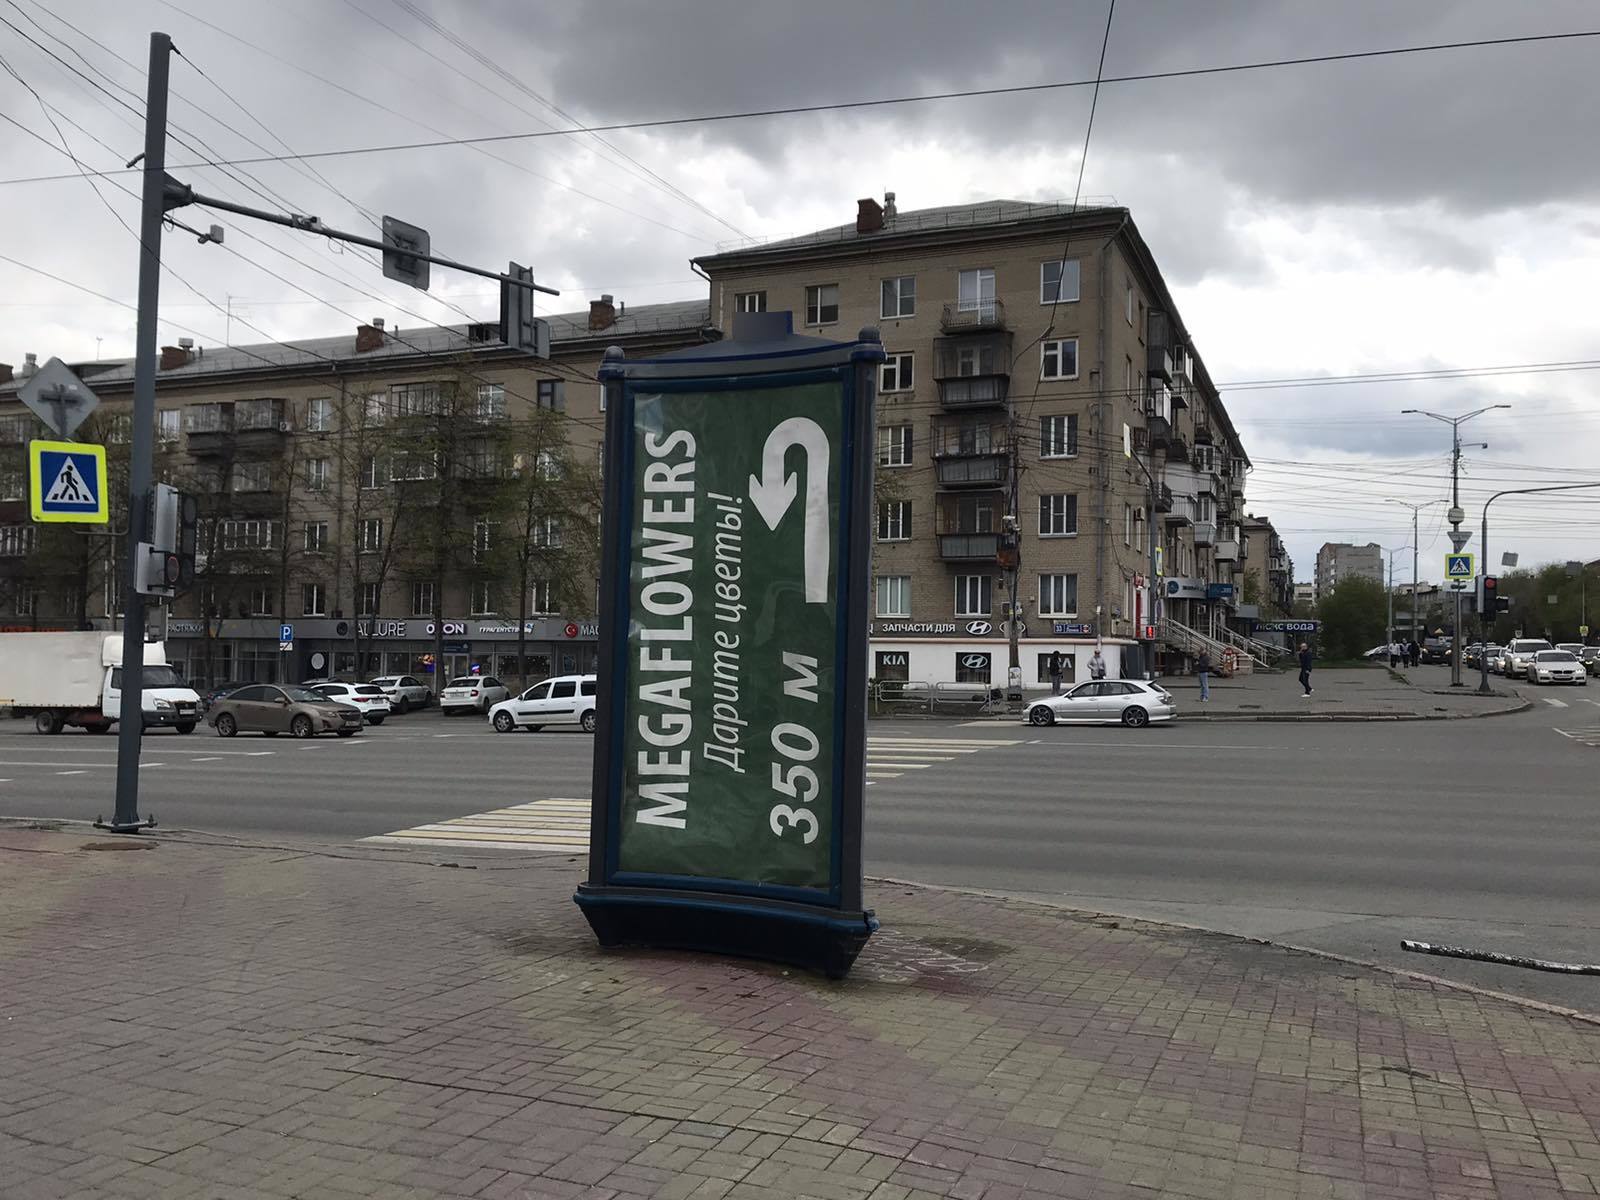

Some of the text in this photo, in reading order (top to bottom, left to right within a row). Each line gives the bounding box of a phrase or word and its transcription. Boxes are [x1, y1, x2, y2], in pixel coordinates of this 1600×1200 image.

[426, 623, 465, 634] OON
[480, 626, 524, 634] ТУРАГЕНТСТВ
[635, 430, 696, 829] MEGAFLOWERS
[703, 492, 748, 773] Дарите цветы!
[882, 624, 933, 632] ЗАПЧАСТИ
[934, 624, 956, 633] ДЛЯ
[769, 722, 820, 845] 350
